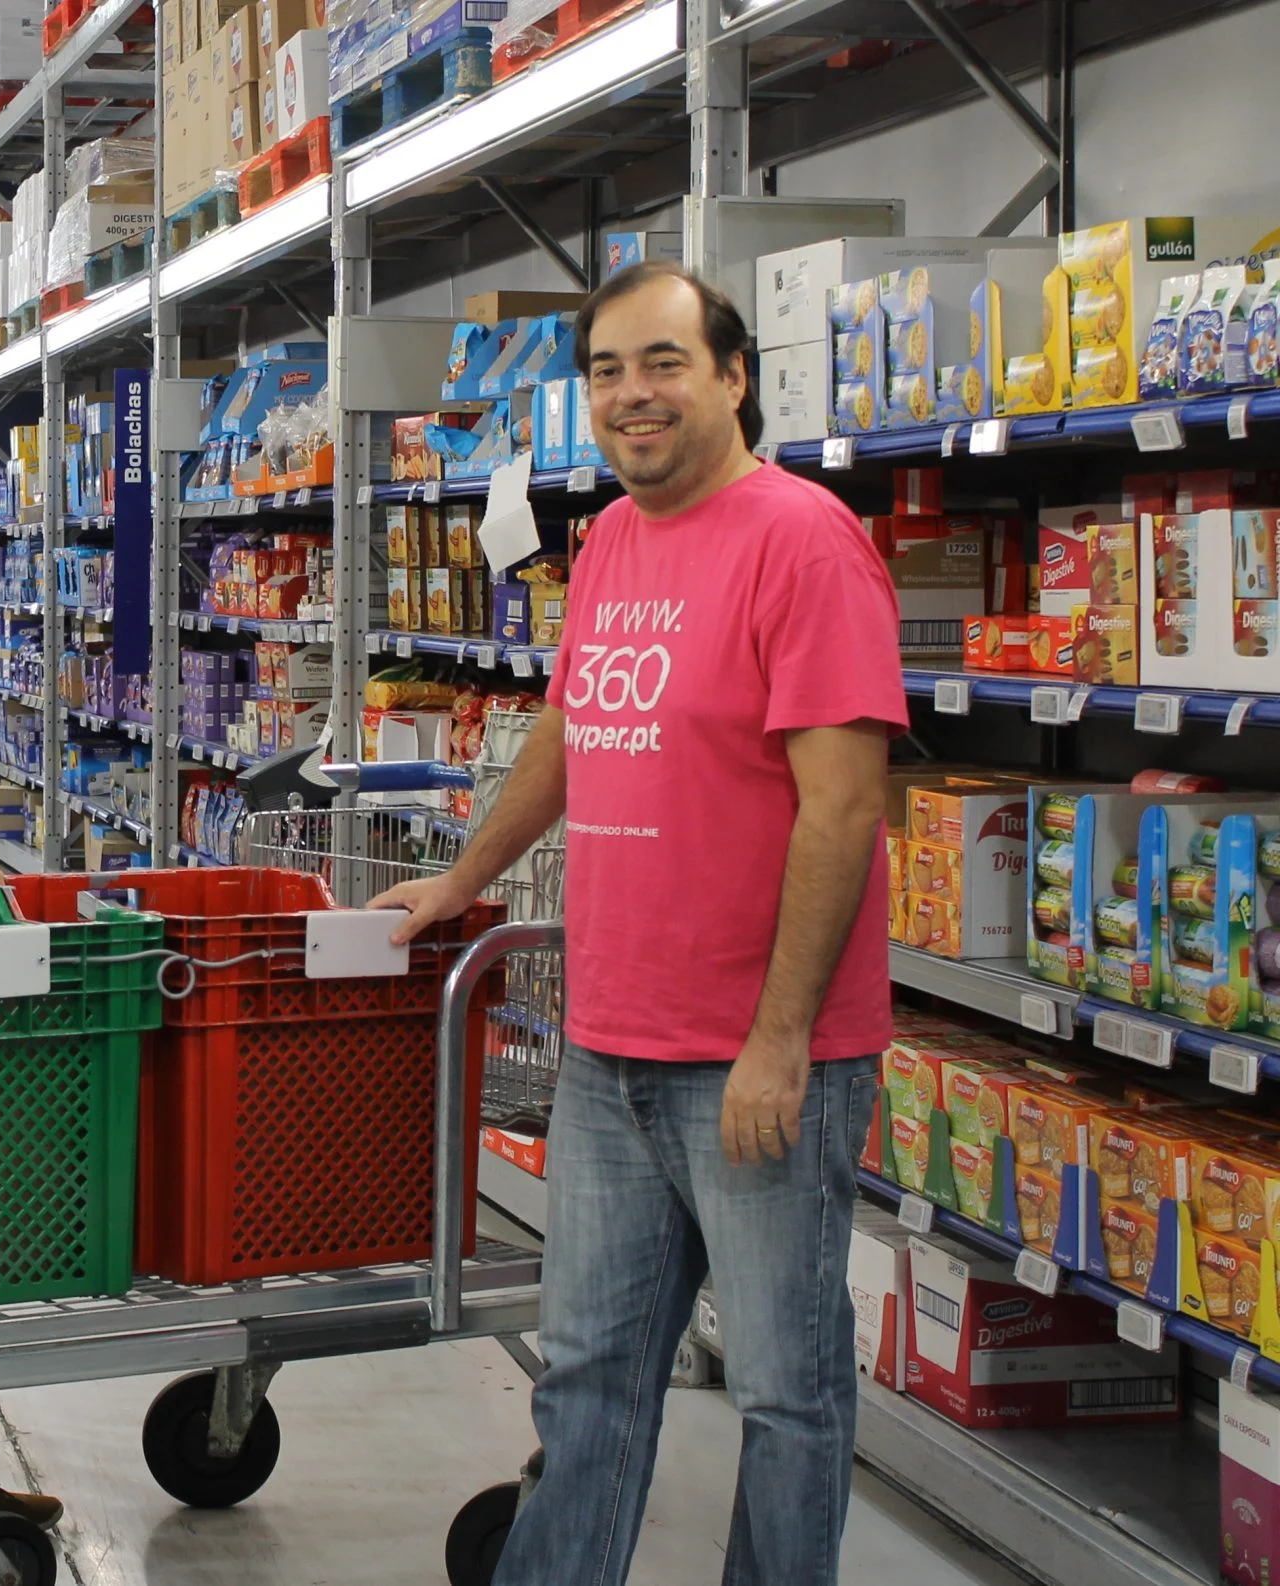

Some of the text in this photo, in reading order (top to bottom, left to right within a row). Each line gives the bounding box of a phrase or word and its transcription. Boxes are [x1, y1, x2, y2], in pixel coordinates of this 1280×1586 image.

[1149, 241, 1192, 259] gullón
[124, 382, 142, 483] Bolachas
[948, 543, 978, 554] 17293
[1099, 535, 1131, 554] Digestive
[1043, 556, 1075, 587] Digestive
[1089, 615, 1131, 635] Digestive
[566, 643, 671, 712] 360
[564, 716, 661, 756] hyper.pt
[623, 827, 659, 837] ONLINE
[982, 926, 1012, 936] 756720
[954, 1078, 977, 1098] TRIUNFO
[1021, 1100, 1044, 1121] TRIUNFO
[1107, 1129, 1135, 1152] TRIUNFO
[1208, 1160, 1240, 1186] TRIUNFO
[1021, 1175, 1045, 1197] TRIUNFO
[1132, 1178, 1146, 1194] GO!
[1106, 1209, 1136, 1235] TRIUNFO
[1237, 1212, 1253, 1230] GO!
[1204, 1244, 1236, 1271] TRIUNFO
[1234, 1299, 1250, 1317] GO!
[978, 1313, 1053, 1347] Digestive
[977, 1407, 988, 1417] 12
[1224, 1414, 1271, 1447] CAIXA EXPOSITORA
